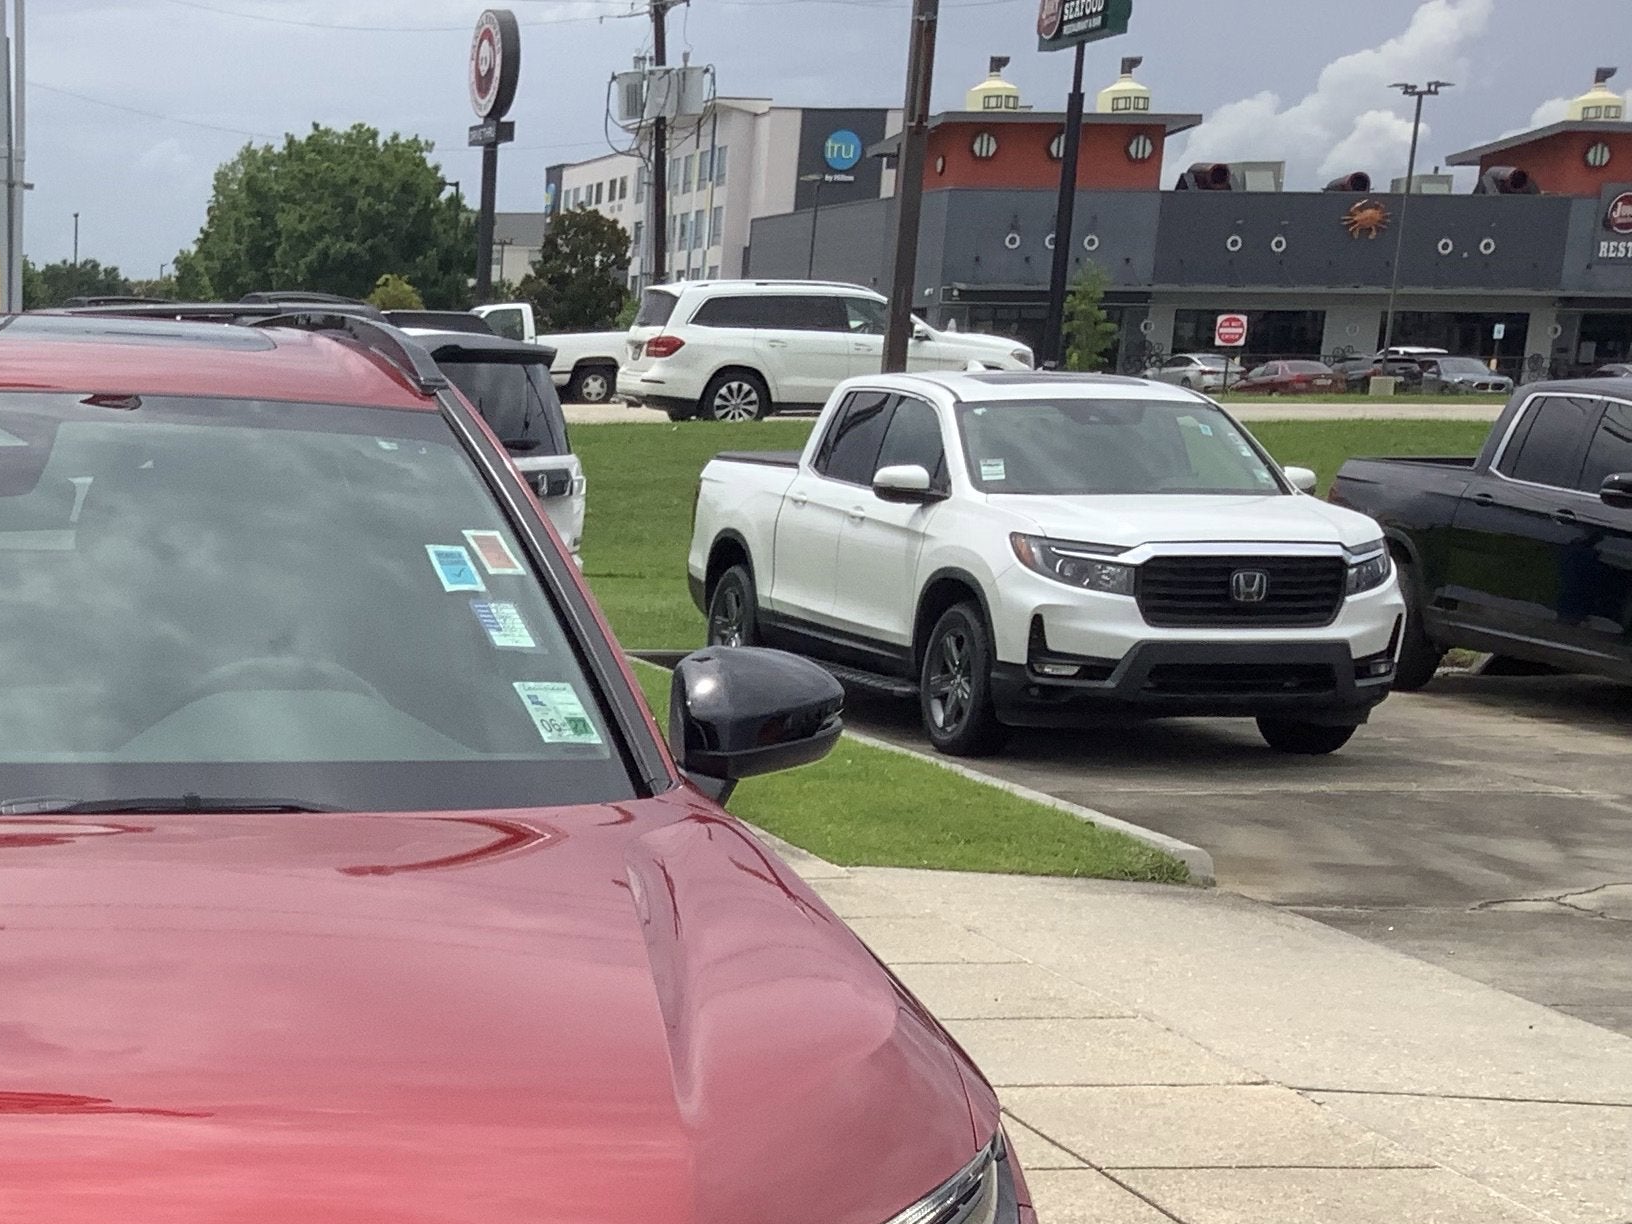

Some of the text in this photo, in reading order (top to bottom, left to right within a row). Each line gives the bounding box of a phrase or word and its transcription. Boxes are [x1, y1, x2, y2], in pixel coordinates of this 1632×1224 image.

[1063, 0, 1104, 21] SEAFOOD
[825, 138, 855, 159] tru
[540, 718, 563, 733] 06
